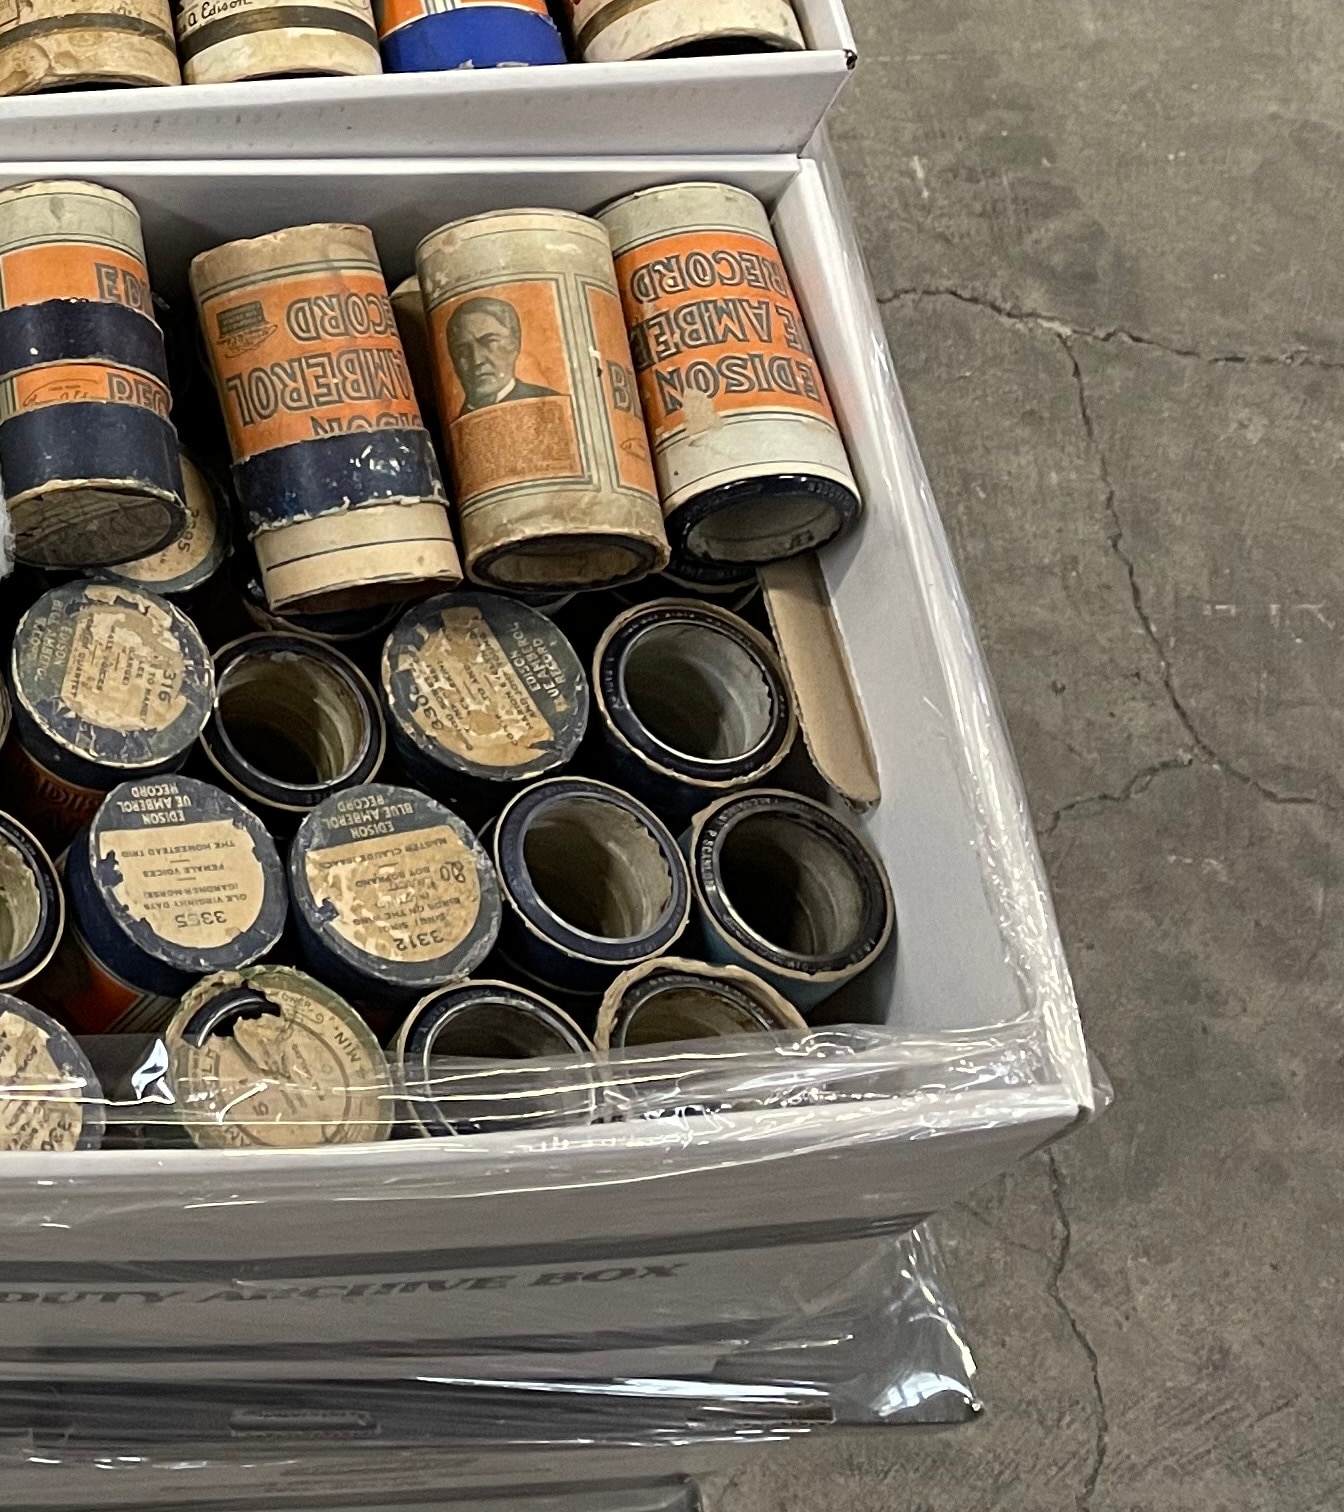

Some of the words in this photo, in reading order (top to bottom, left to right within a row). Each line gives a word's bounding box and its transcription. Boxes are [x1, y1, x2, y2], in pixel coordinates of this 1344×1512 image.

[628, 249, 790, 296] RECORD
[654, 361, 817, 413] EDISON
[131, 783, 179, 798] RECORD
[117, 796, 172, 812] AMBEROL
[337, 795, 385, 812] RECORD
[384, 802, 414, 818] BLUE
[141, 810, 186, 824] EDISON
[321, 806, 381, 829] AMBEROL
[350, 821, 395, 838] EDISON
[147, 843, 212, 854] HOMESTEAD
[393, 929, 445, 952] 3312
[198, 1272, 513, 1304] ARCHIVE
[530, 1261, 689, 1285] BOX
